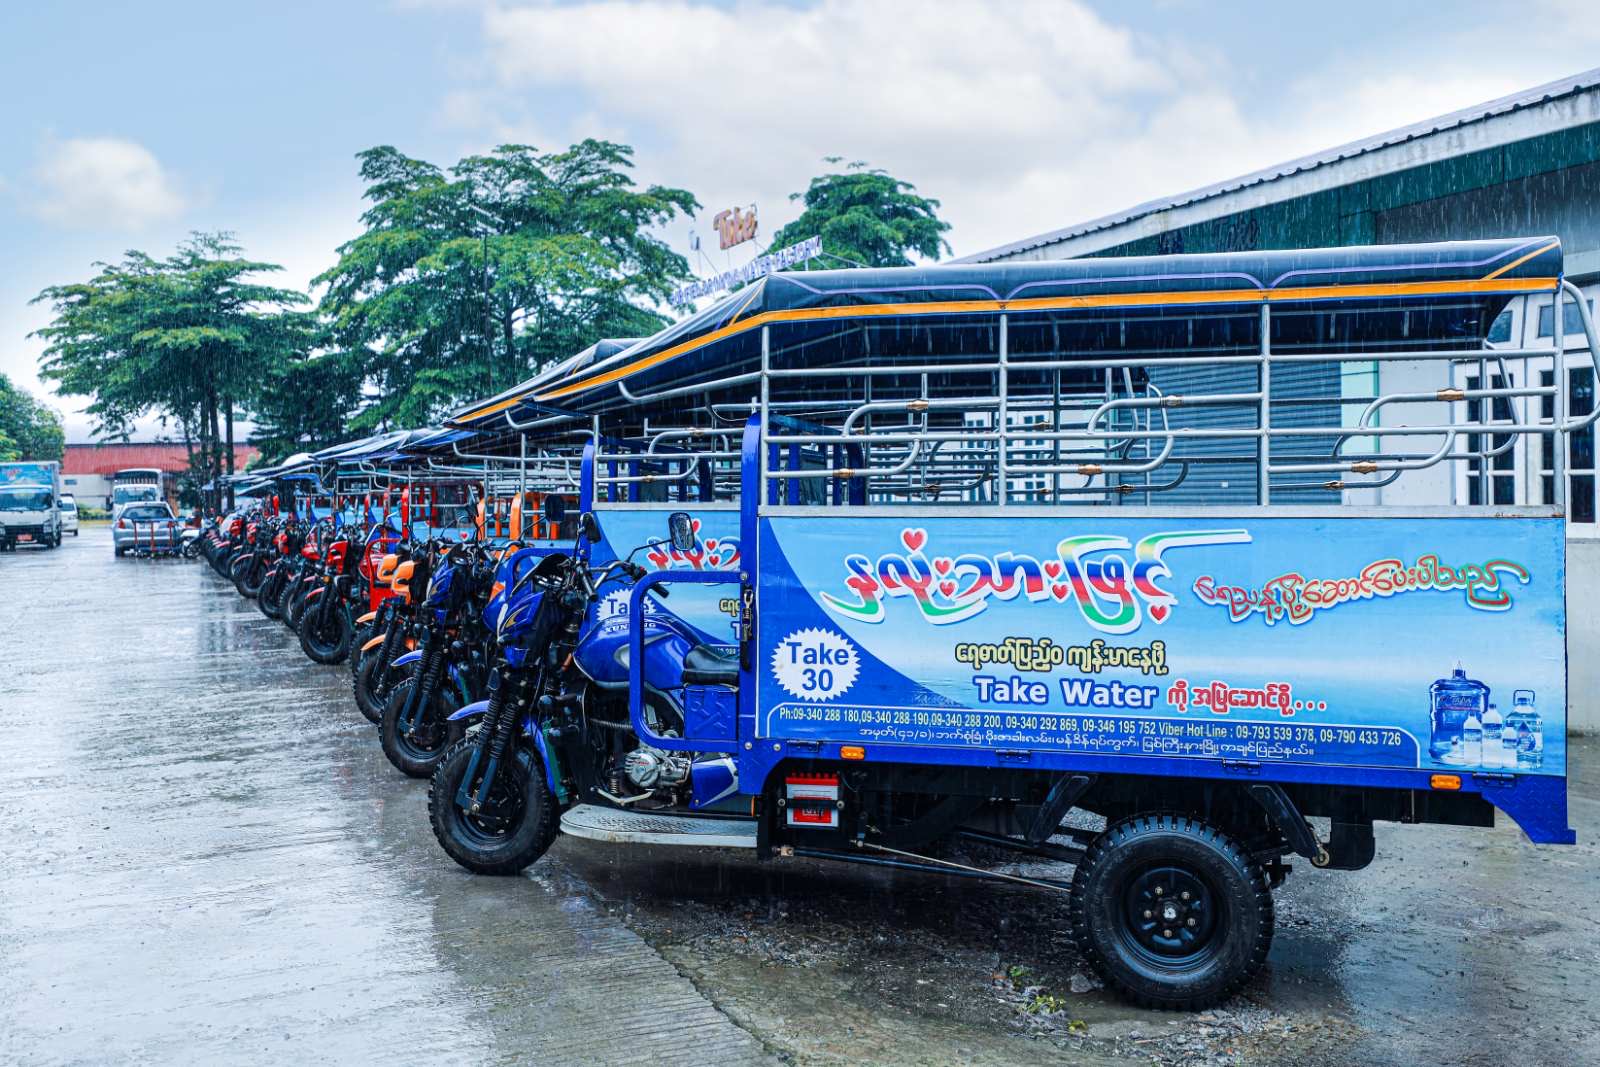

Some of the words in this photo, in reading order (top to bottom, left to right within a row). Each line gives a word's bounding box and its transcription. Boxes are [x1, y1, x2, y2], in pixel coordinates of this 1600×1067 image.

[607, 599, 649, 614] Tae
[786, 642, 849, 665] Take
[802, 668, 833, 691] 30
[974, 676, 1048, 703] Take
[1060, 678, 1158, 707] Water
[1168, 680, 1187, 712] ကို
[779, 707, 823, 721] Ph:09-340
[825, 708, 841, 722] 288
[894, 711, 910, 725] 288
[965, 714, 981, 728] 288
[984, 716, 1003, 731] 200,
[1006, 716, 1038, 730] 09-340
[1040, 717, 1057, 731] 292
[1060, 718, 1080, 734] 869,
[1083, 719, 1115, 734] 09-346
[1118, 720, 1136, 735] 195
[1139, 721, 1156, 736] 752
[1159, 722, 1184, 737] Viber
[1187, 723, 1203, 737] Hot
[1206, 723, 1227, 738] Line
[1236, 725, 1270, 740] 09-793
[1273, 727, 1292, 741] 539
[1295, 728, 1317, 744] 378,
[1320, 729, 1356, 744] 09-790
[1359, 730, 1378, 745] 433
[1381, 731, 1401, 746] 726
